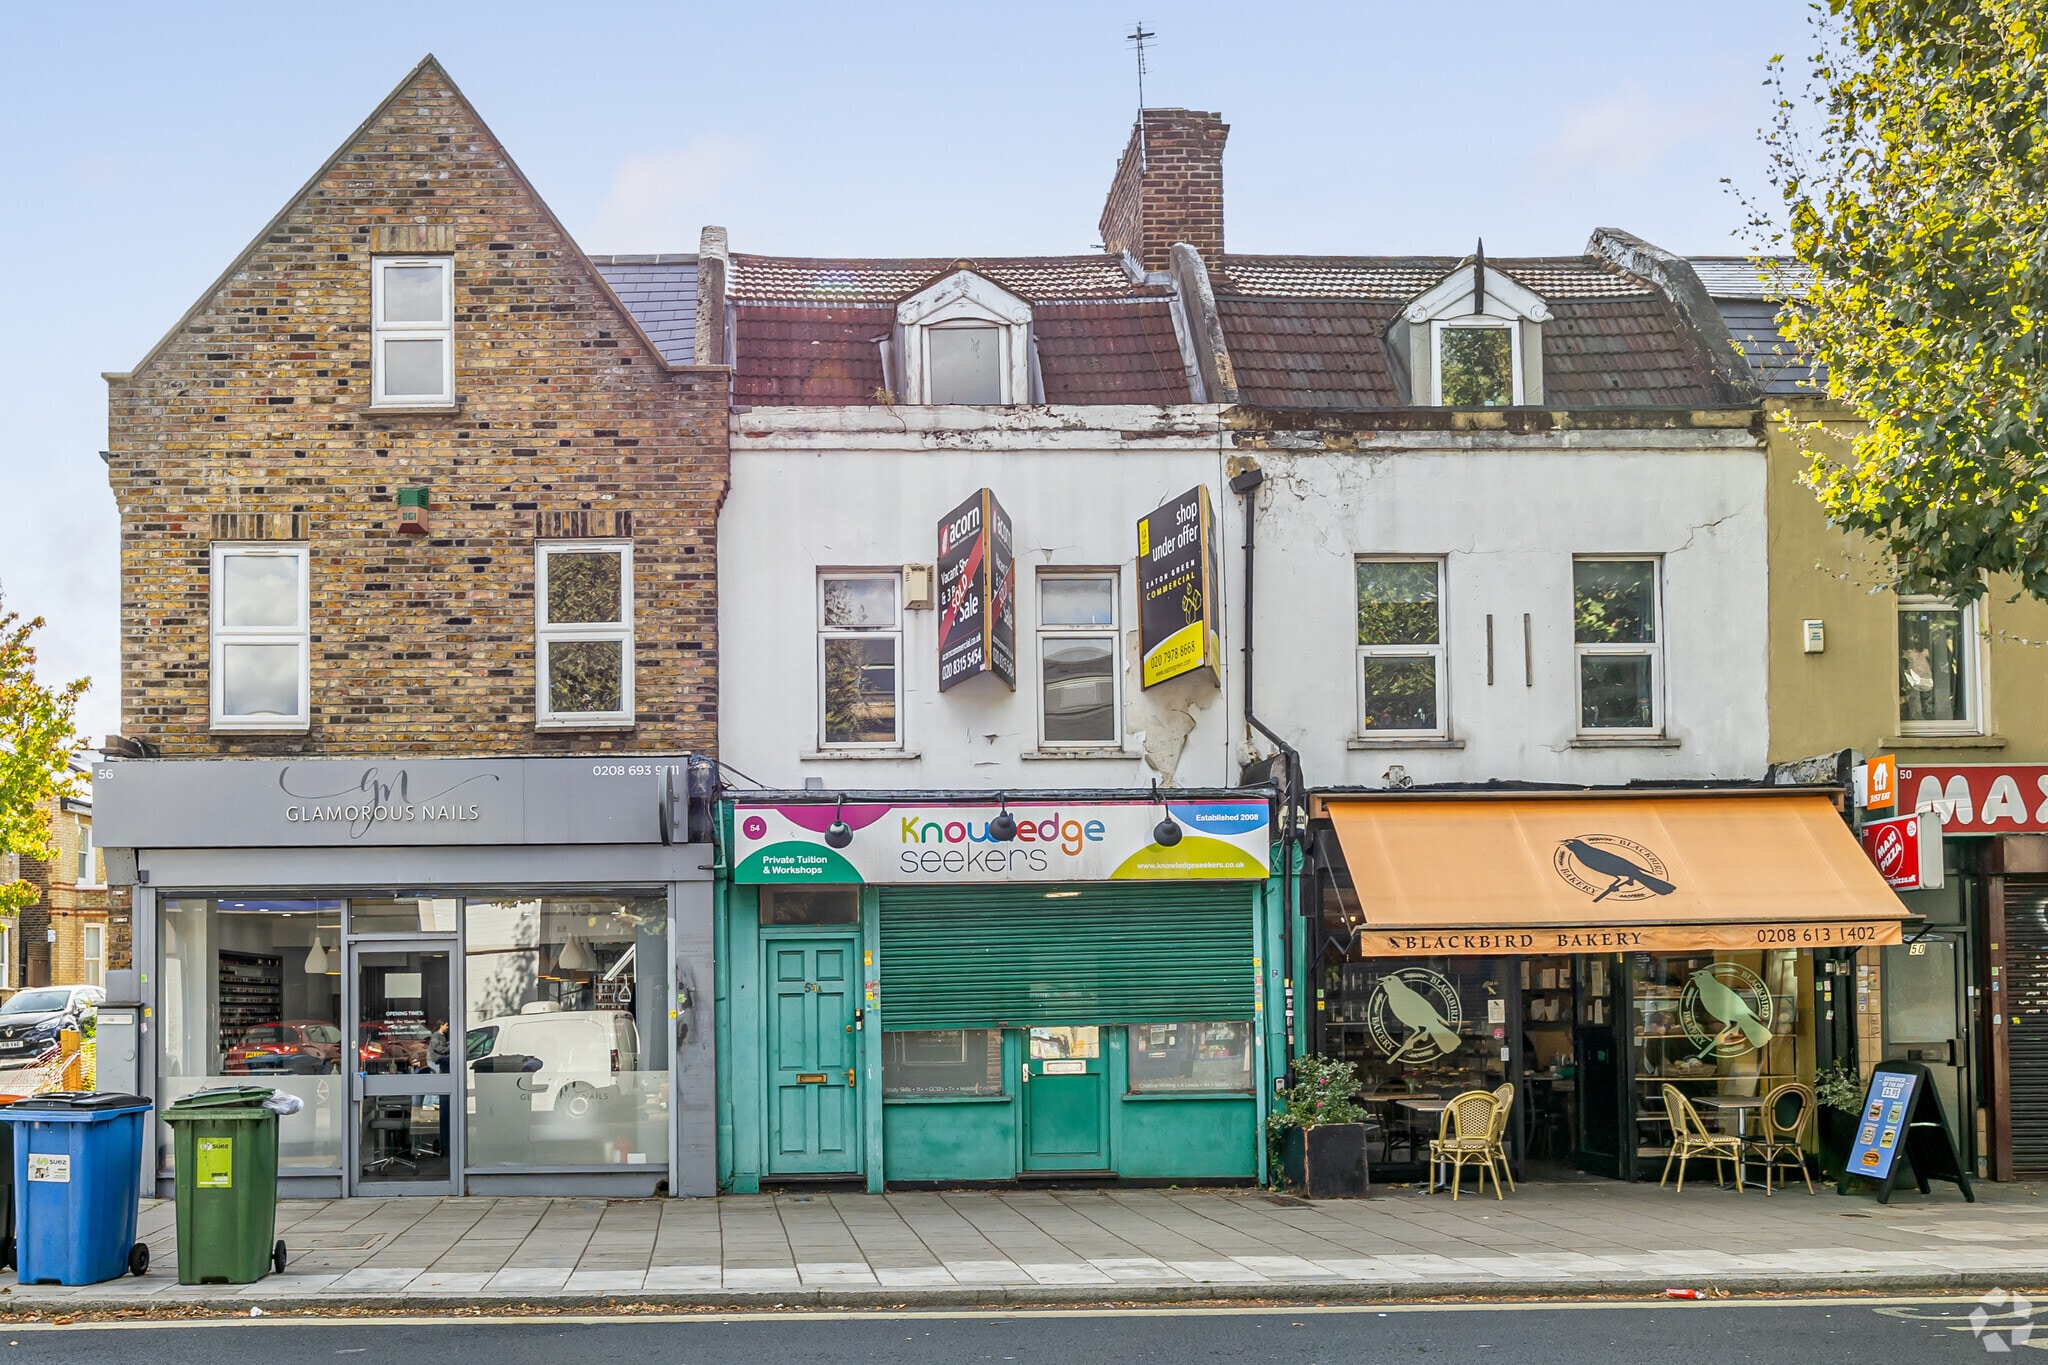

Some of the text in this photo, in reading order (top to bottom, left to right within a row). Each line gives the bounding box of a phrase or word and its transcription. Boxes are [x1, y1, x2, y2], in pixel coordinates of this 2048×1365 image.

[950, 506, 980, 543] acorn
[1176, 502, 1197, 525] shop
[1152, 536, 1176, 562] under
[1177, 523, 1198, 548] offer
[940, 564, 959, 586] Vacant
[1146, 559, 1195, 589] EATON GREEN
[1146, 571, 1195, 601] COMMERCIAL
[952, 574, 968, 614] SOLD
[942, 663, 952, 680] 020
[953, 655, 967, 675] 8315
[967, 646, 982, 667] 5454
[1151, 654, 1162, 669] 020
[98, 769, 113, 779] 56
[593, 766, 625, 776] 0208
[628, 766, 651, 776] 693
[1900, 769, 1912, 779] 50
[1869, 791, 1891, 804] JUST EAT
[286, 804, 480, 822] GLAMOROUS NAILS
[1240, 813, 1259, 821] 2008
[901, 812, 1106, 856] Knowedge
[1877, 830, 1897, 859] MAXI
[762, 856, 828, 864] Private Tuition
[762, 866, 823, 875] & Workshops
[900, 842, 1048, 873] seekers
[1136, 861, 1245, 869] www.knowledgeseekers.co.uk
[1620, 839, 1663, 876] BLACKBIRD
[1880, 842, 1902, 872] PIZZA
[1560, 867, 1599, 894] BAKERY
[1406, 931, 1642, 949] BLACKBIRD BAKERY
[1757, 926, 1876, 943] 0208 613 1402
[1911, 944, 1925, 954] 50
[1430, 976, 1458, 1023] BLACKBIRD
[1740, 971, 1769, 1018] BLACKBIRD
[1372, 1016, 1395, 1050] BAKERY
[1683, 1011, 1706, 1045] BAKERY
